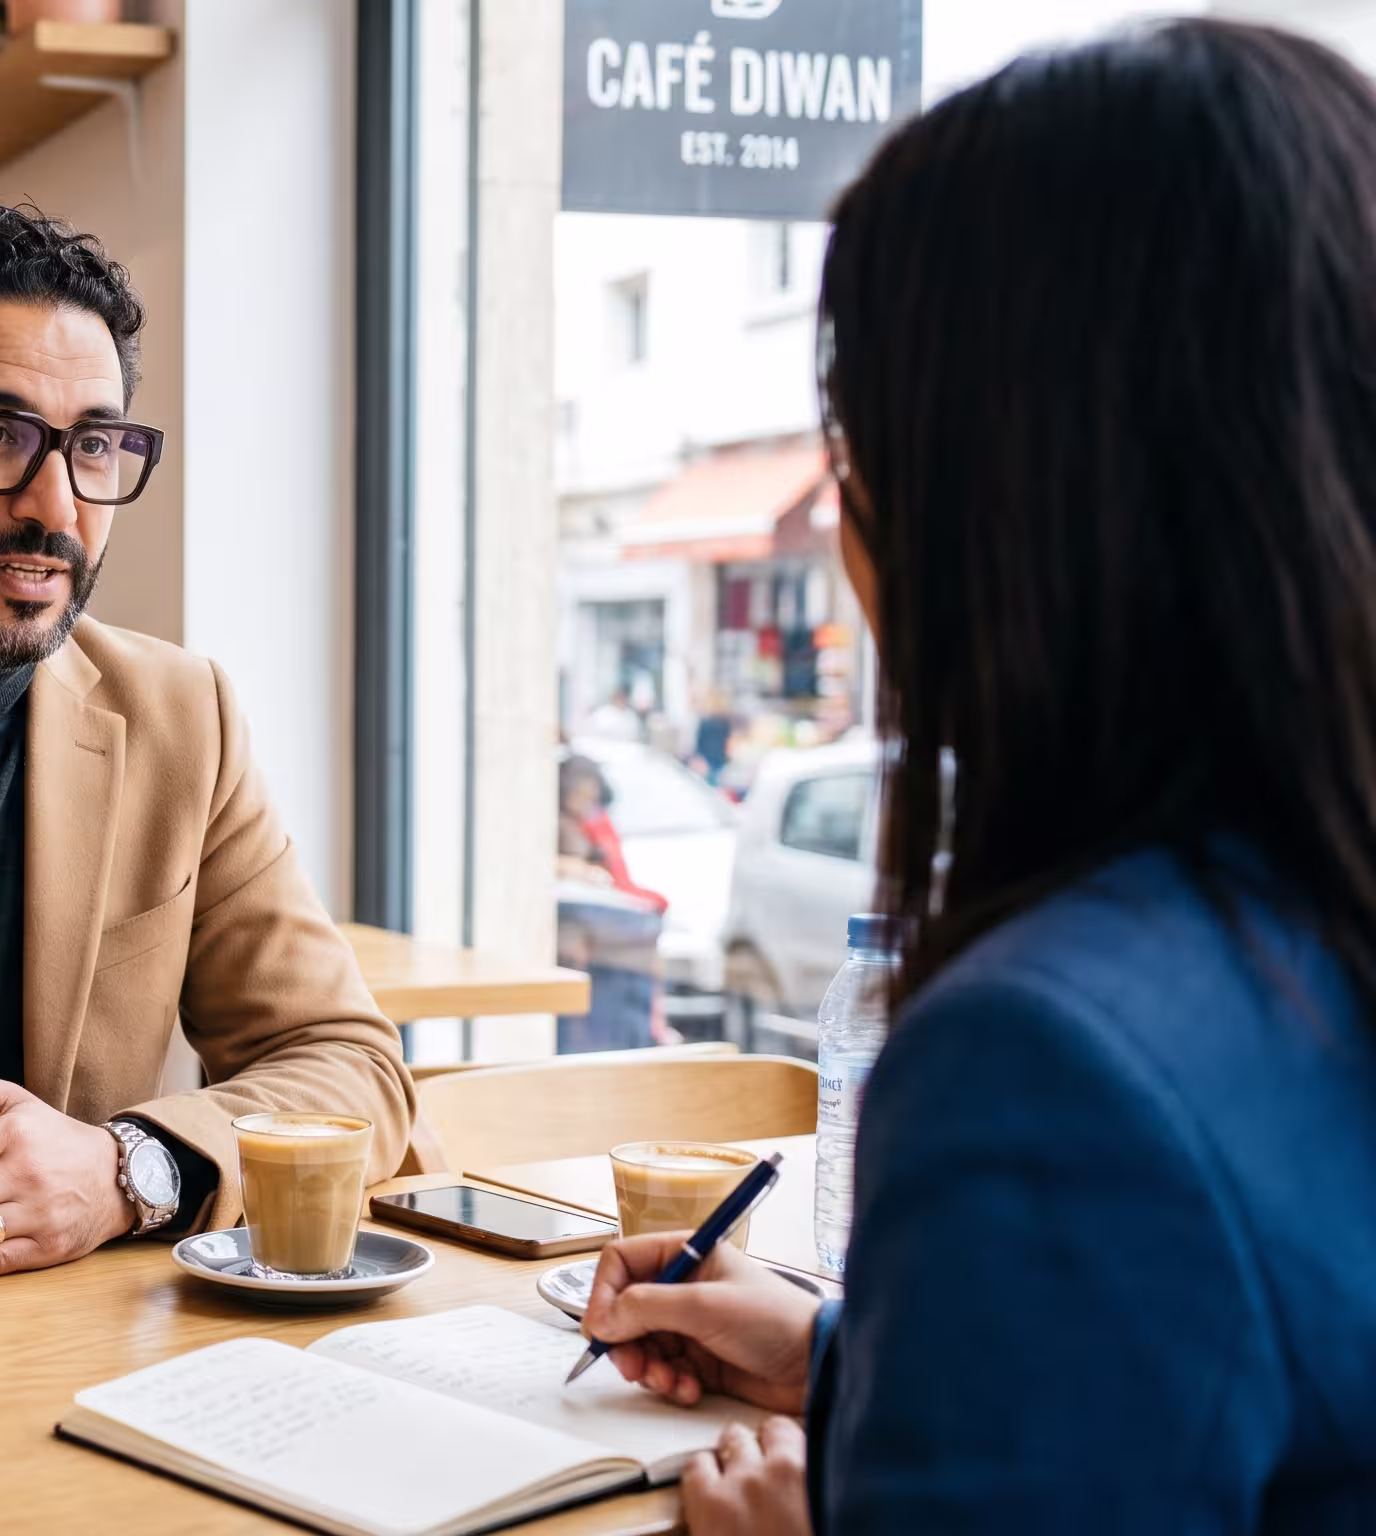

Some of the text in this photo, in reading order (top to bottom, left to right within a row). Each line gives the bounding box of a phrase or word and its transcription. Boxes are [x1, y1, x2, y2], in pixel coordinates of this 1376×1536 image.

[586, 30, 892, 122] CAFÉ DIWAN
[680, 131, 800, 170] EST. 2014
